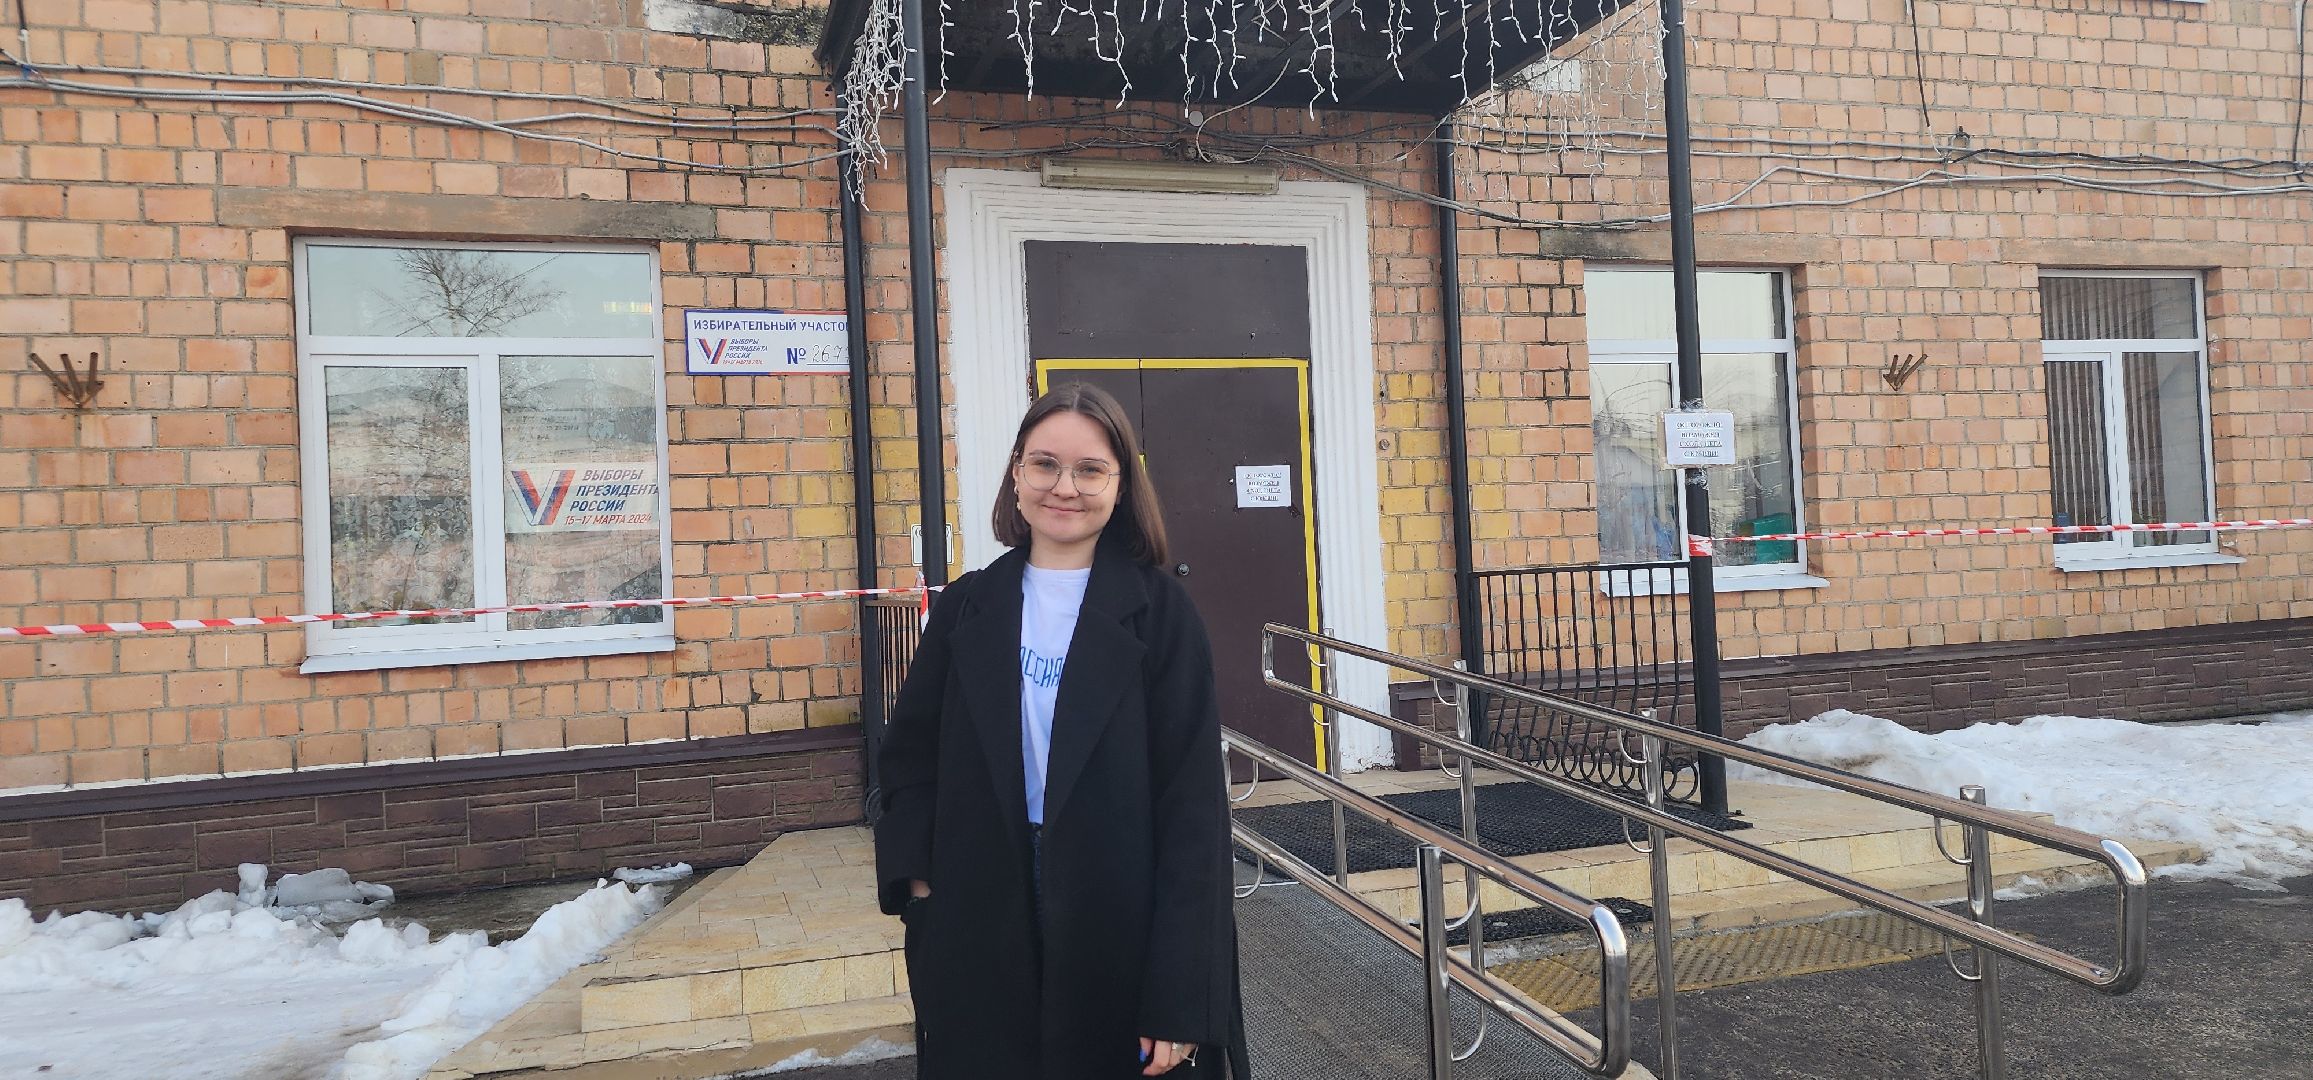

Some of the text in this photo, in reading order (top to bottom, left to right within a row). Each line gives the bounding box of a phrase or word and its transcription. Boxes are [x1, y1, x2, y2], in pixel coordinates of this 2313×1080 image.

[693, 318, 848, 332] ИЗБИРАТЕЛЬНЫЙ УЧАСТО
[786, 347, 807, 365] №
[582, 469, 644, 482] ВЫБОРЫ
[569, 500, 626, 512] РОССИИ
[593, 514, 626, 525] МАРТА
